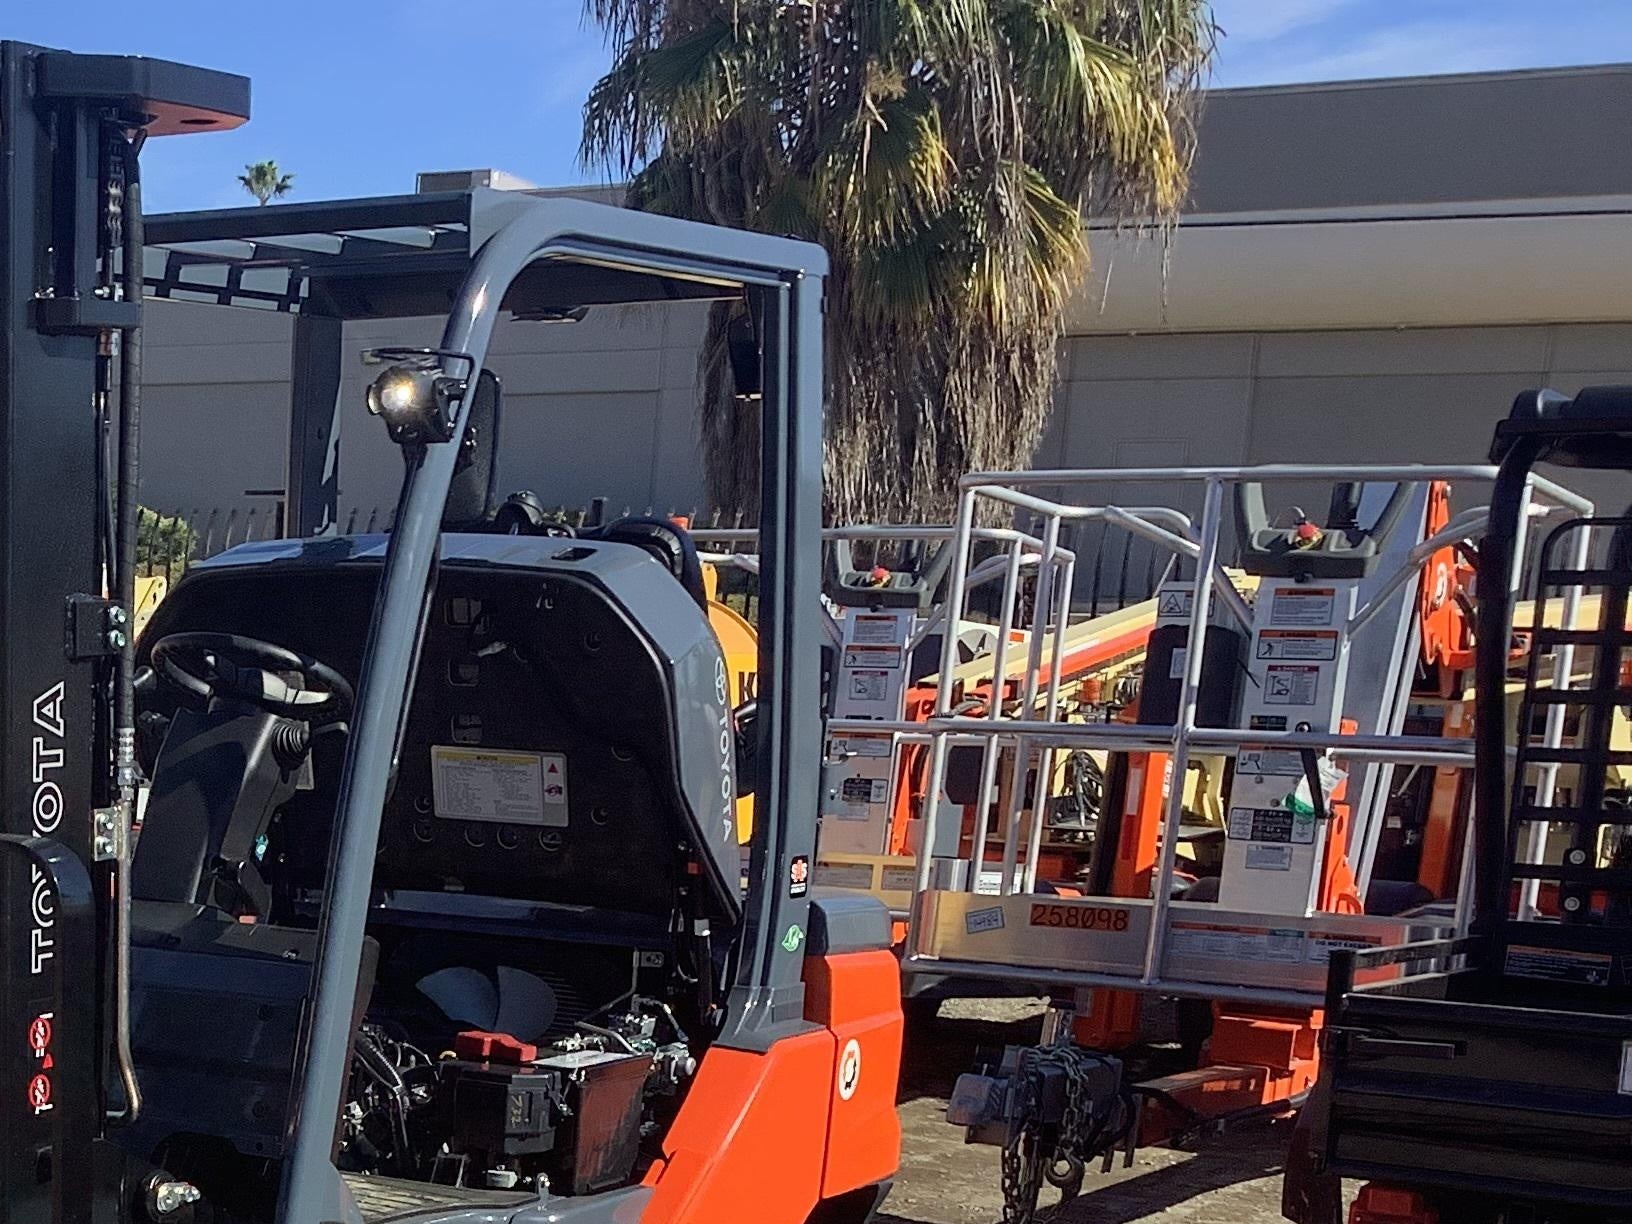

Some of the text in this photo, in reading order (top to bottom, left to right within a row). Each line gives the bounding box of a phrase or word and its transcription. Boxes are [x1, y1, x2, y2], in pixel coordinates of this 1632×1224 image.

[31, 680, 65, 974] TOOTA
[719, 708, 732, 843] TOYOTA
[1032, 904, 1129, 932] 258098
